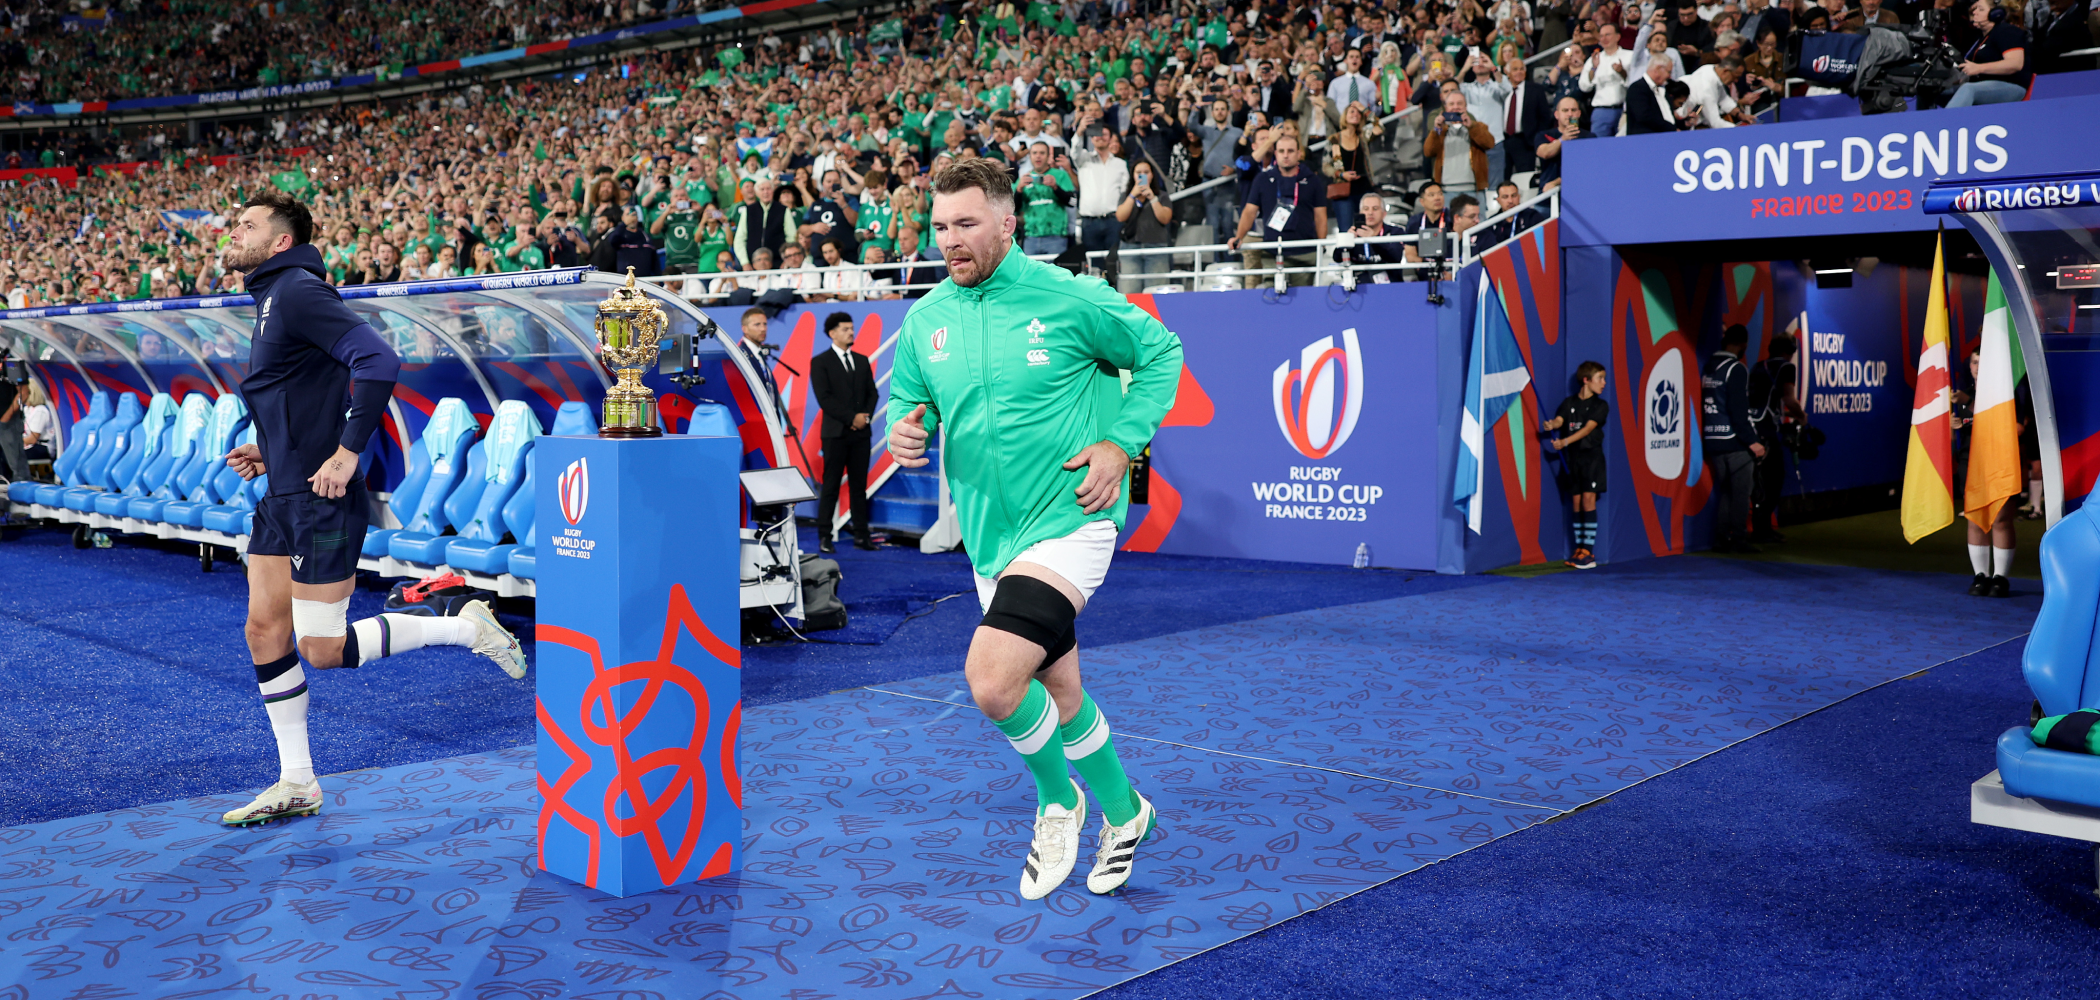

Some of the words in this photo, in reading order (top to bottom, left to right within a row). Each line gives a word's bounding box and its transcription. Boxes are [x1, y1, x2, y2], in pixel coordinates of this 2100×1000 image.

[1852, 189, 1912, 213] 2023
[1985, 184, 2081, 210] RUGBY
[490, 278, 512, 290] RUGBY
[513, 275, 538, 287] WORLD
[540, 273, 554, 286] CUP
[555, 272, 574, 284] 2023
[1813, 332, 1845, 354] RUGBY
[1813, 359, 1862, 388] WORLD
[1863, 360, 1887, 388] CUP
[1813, 393, 1848, 414] FRANCE
[1850, 393, 1872, 413] 2023
[1650, 439, 1680, 450] SCOTLAND
[1290, 466, 1342, 481] RUGBY
[1252, 482, 1334, 503] WORLD
[1338, 484, 1383, 505] CUP
[1265, 504, 1323, 520] FRANCE
[1326, 506, 1367, 522] 2023
[564, 528, 582, 537] RUGBY
[552, 536, 579, 548] WORLD
[580, 539, 596, 551] CUP
[556, 548, 576, 557] FRANCE
[577, 550, 590, 559] 2023
